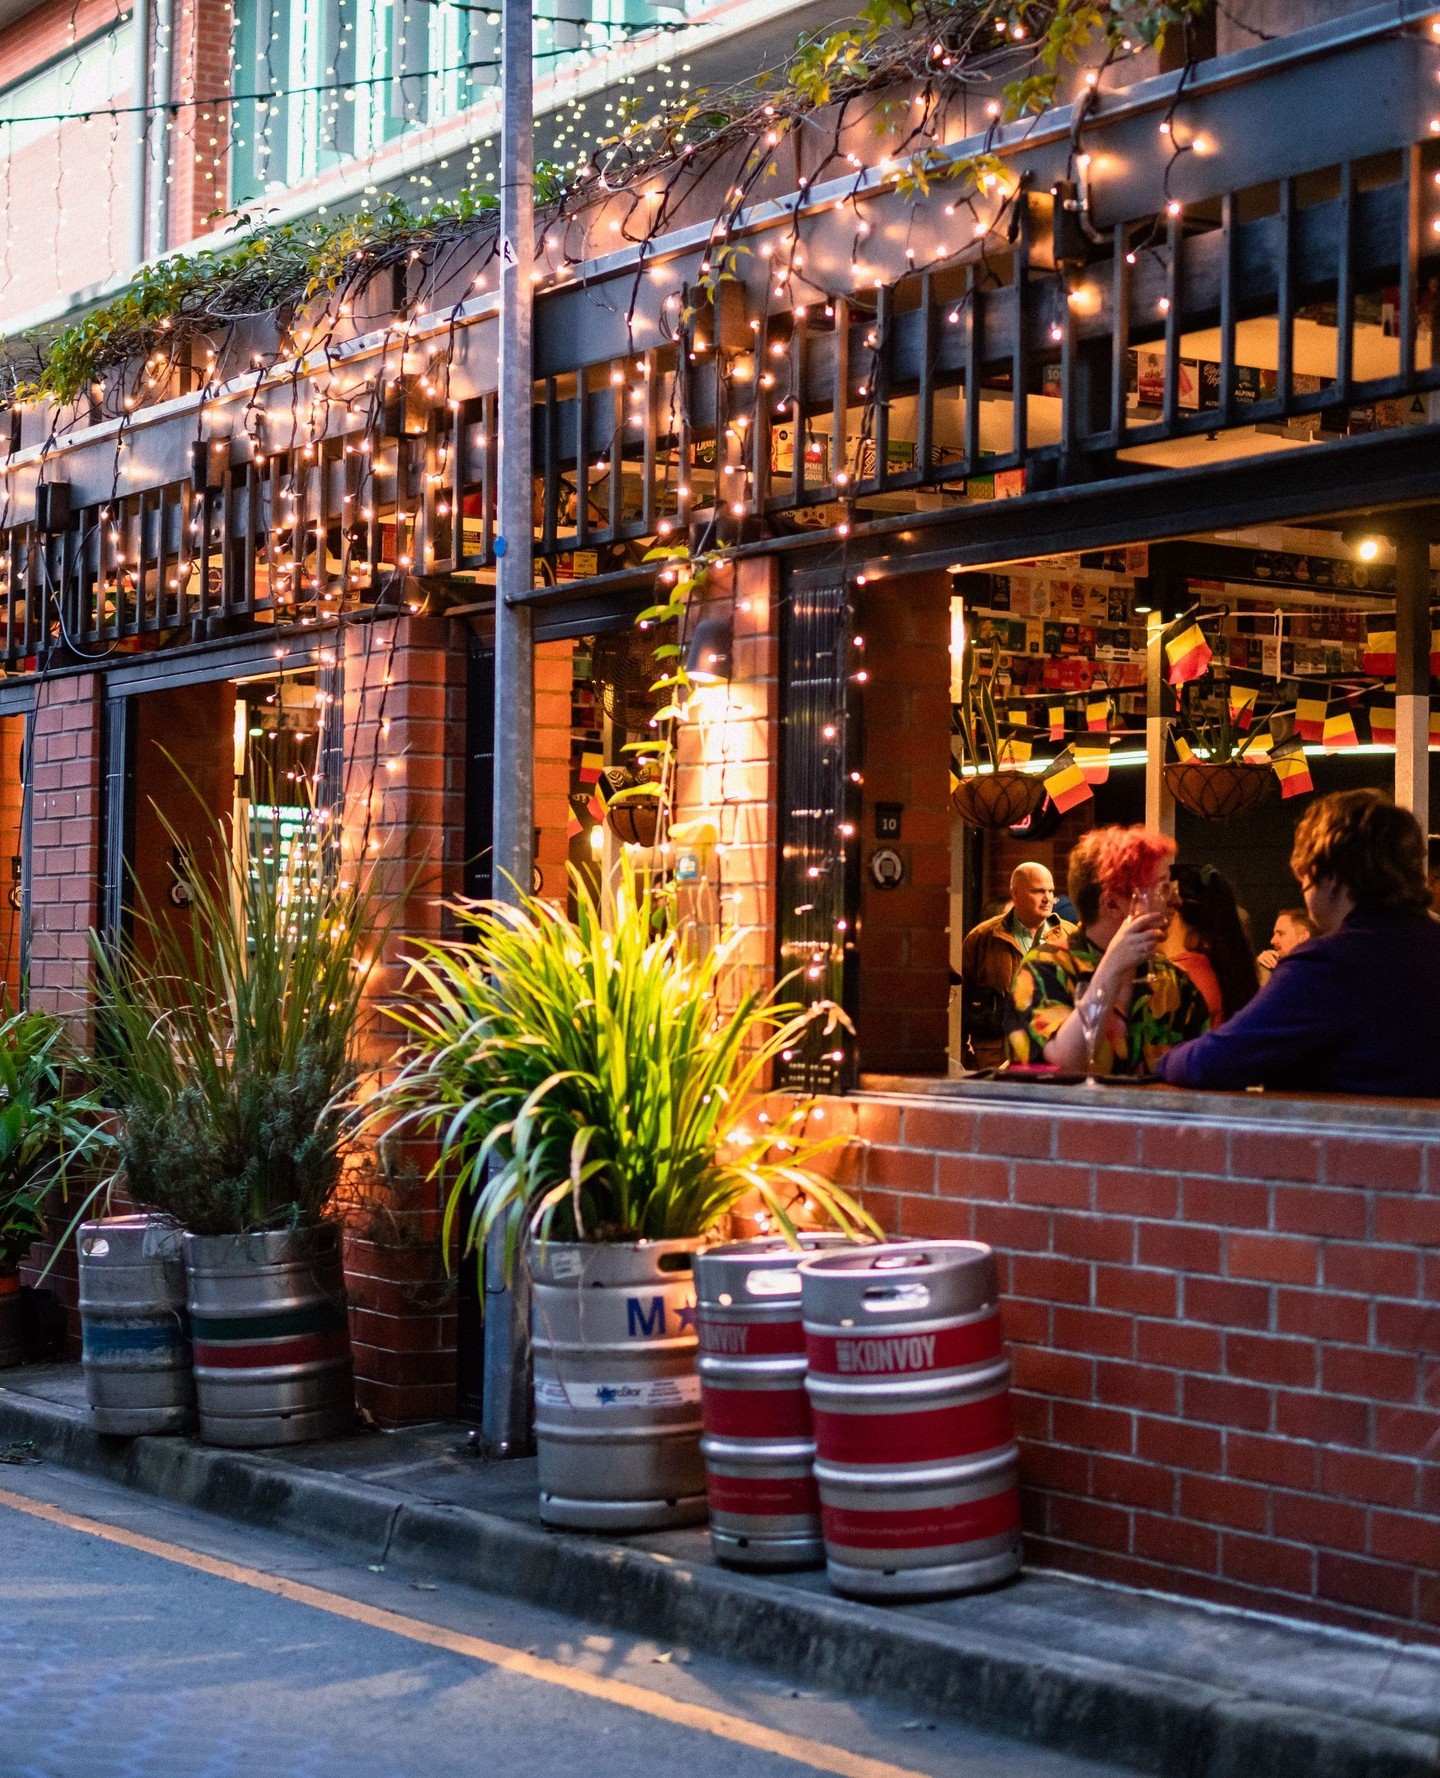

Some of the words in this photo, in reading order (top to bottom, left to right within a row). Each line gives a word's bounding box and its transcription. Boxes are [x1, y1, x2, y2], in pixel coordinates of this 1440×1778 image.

[1234, 390, 1256, 398] ALPINE
[804, 462, 823, 471] PINK
[804, 473, 823, 481] SOUR
[882, 818, 897, 831] 10
[627, 1296, 666, 1337] M
[852, 1334, 937, 1372] KONVOY
